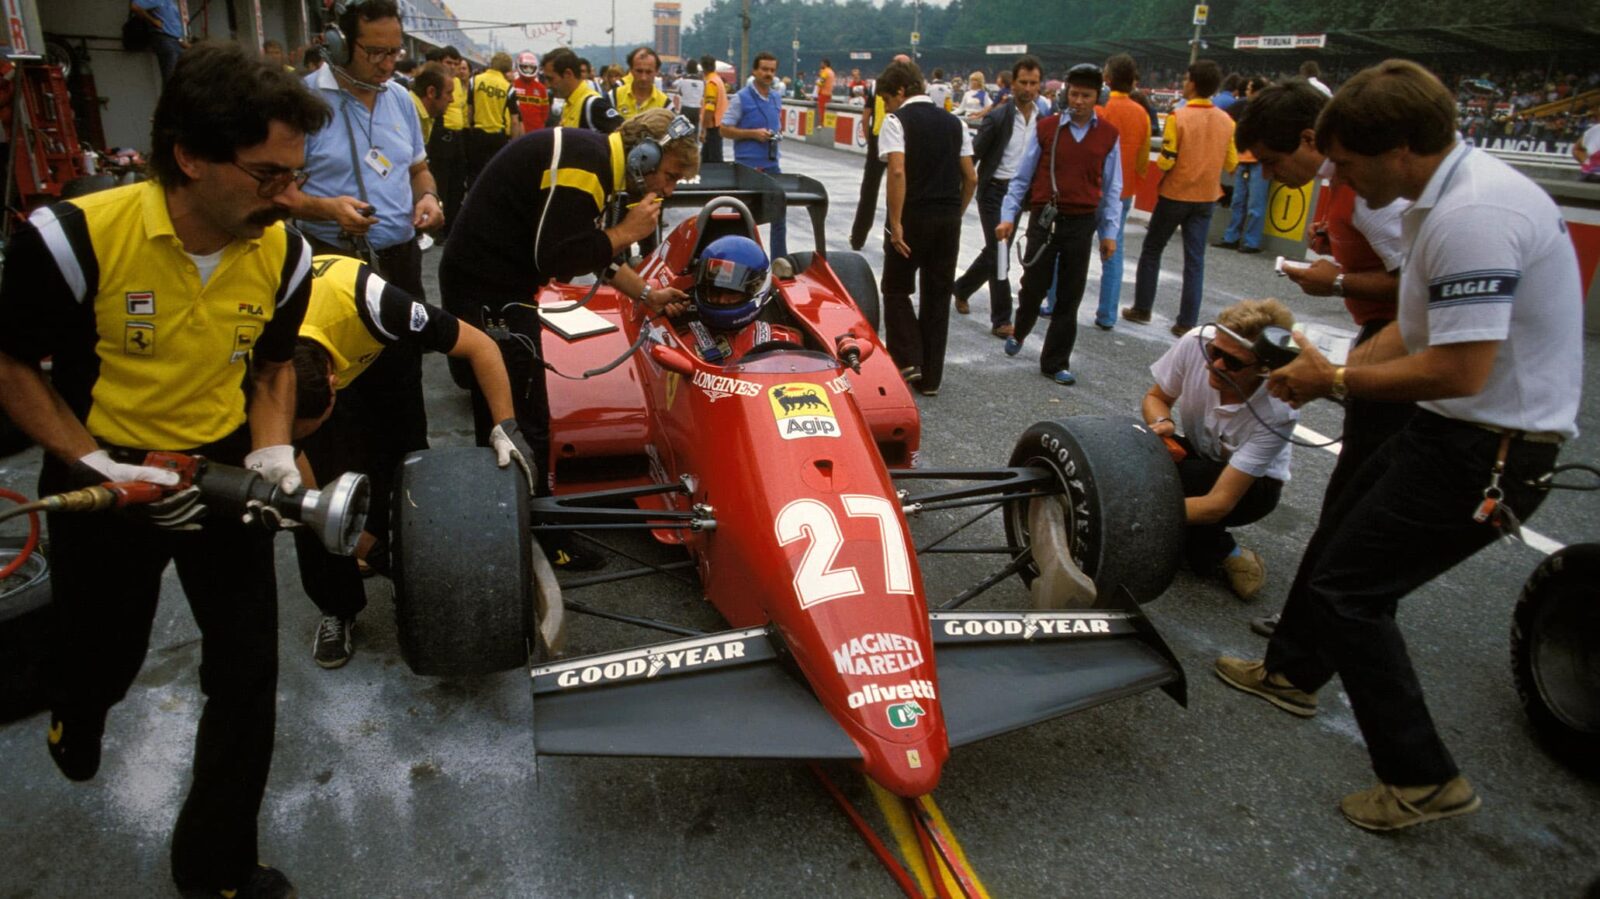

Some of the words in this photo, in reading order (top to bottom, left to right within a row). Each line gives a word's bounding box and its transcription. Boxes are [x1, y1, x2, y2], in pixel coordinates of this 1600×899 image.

[477, 81, 507, 99] Agip
[1480, 138, 1547, 153] LANCIA
[1441, 279, 1501, 298] EAGLE
[239, 303, 264, 316] FILA
[692, 369, 763, 397] LONGINES
[786, 417, 836, 436] Agip
[774, 494, 915, 610] 27
[833, 633, 924, 664] MAGNETI
[833, 645, 924, 676] MARELLI
[847, 679, 936, 710] olivetti
